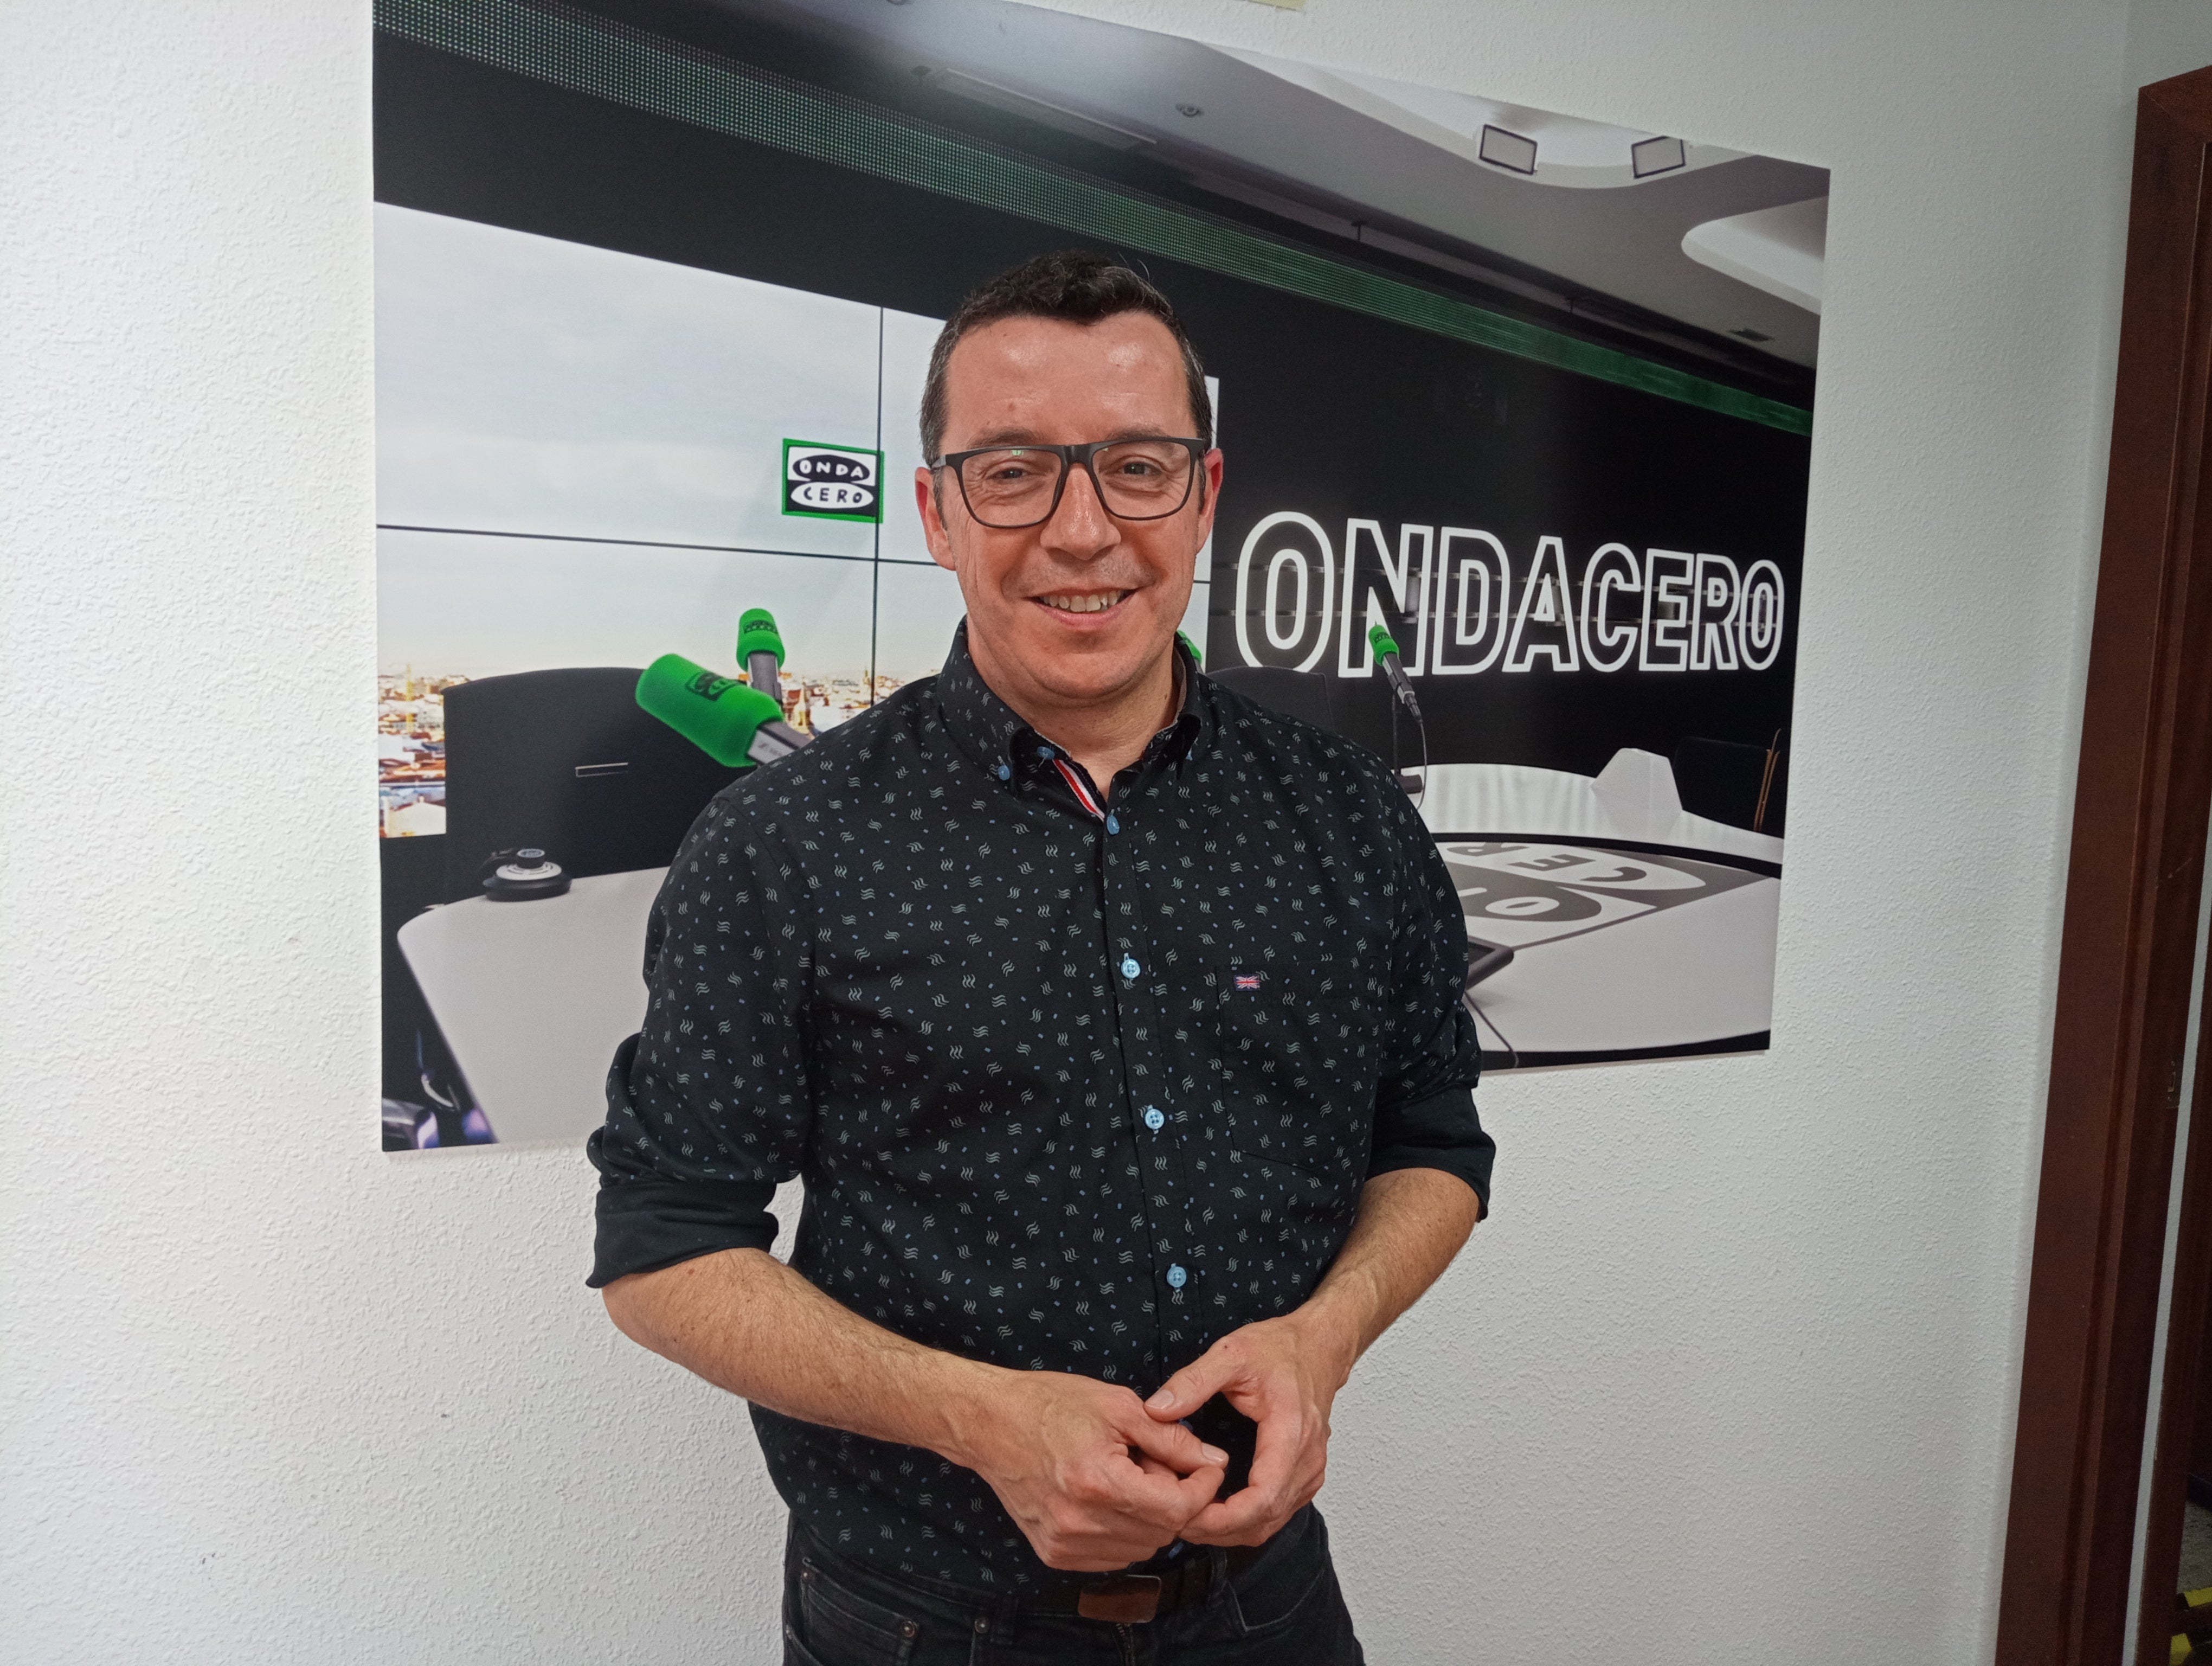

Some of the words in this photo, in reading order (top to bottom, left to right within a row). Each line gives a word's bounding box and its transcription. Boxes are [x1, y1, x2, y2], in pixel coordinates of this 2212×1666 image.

[799, 460, 864, 478] ONDA
[803, 486, 863, 504] CERO
[1236, 511, 1784, 678] ONDACERO
